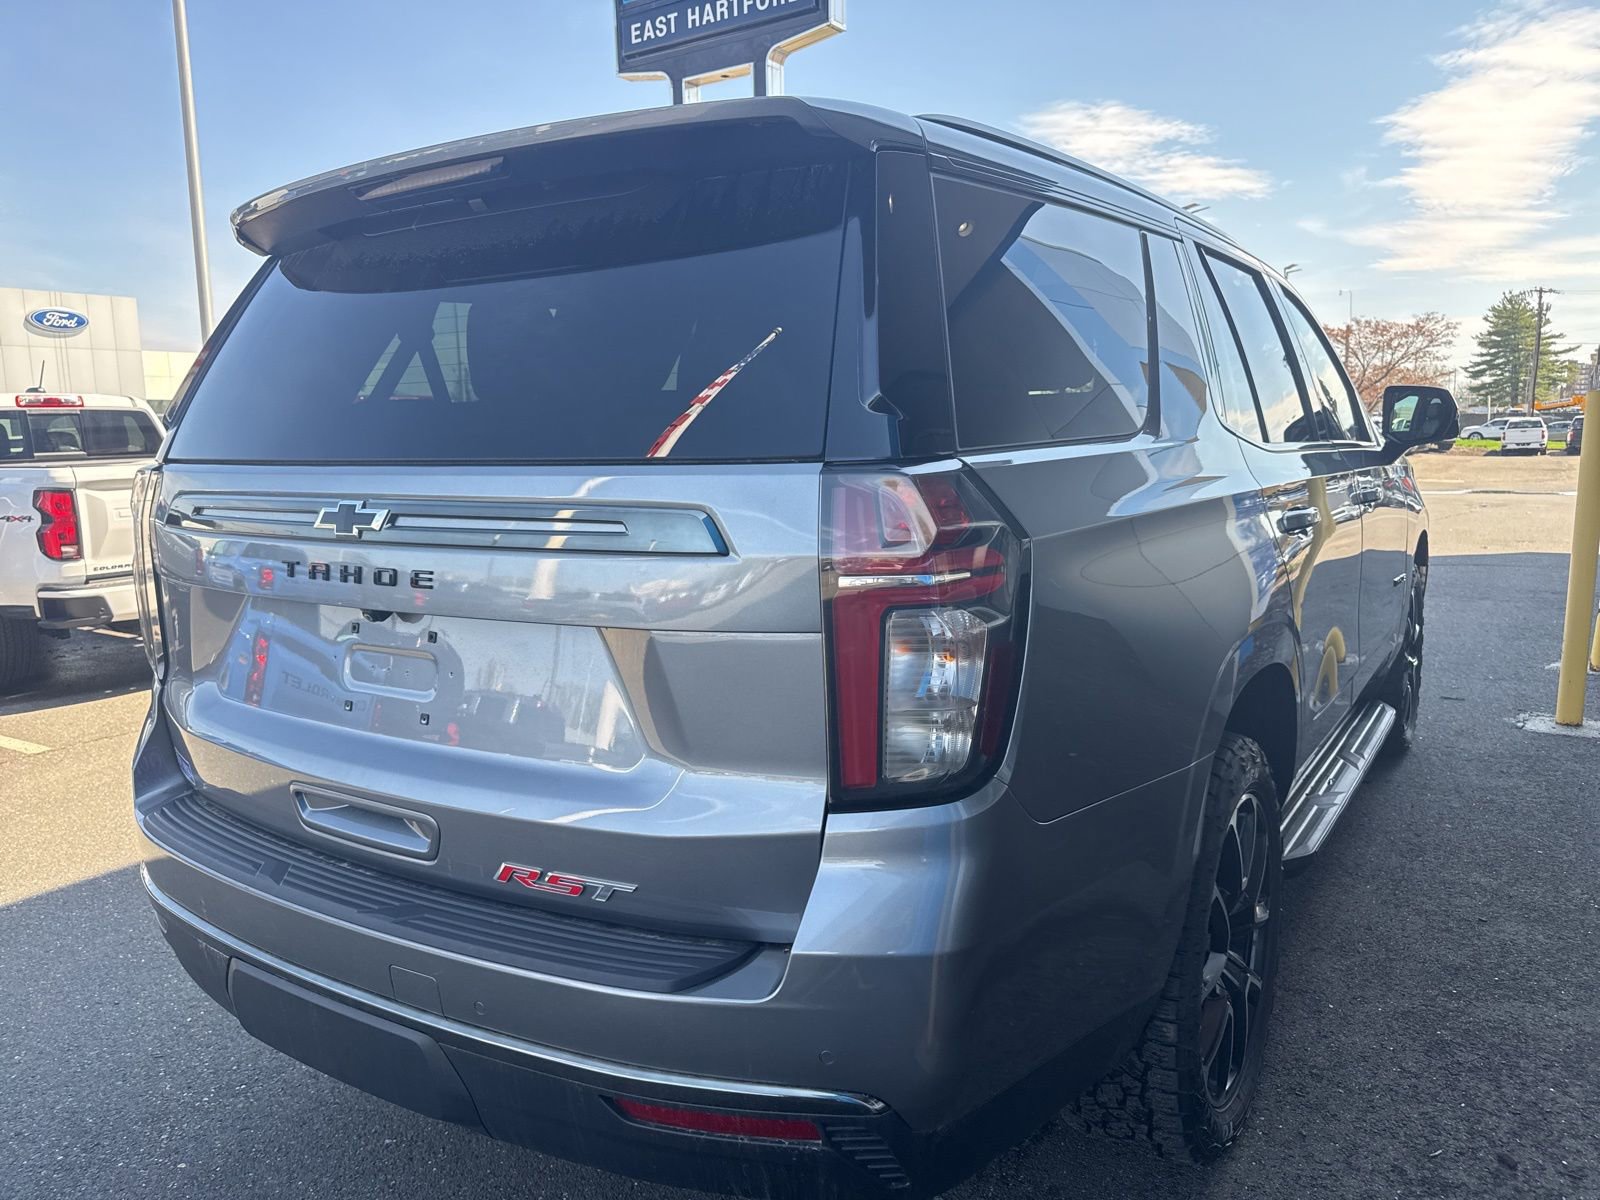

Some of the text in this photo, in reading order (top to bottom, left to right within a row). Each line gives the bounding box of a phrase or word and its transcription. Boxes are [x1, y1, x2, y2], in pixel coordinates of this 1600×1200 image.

[630, 0, 798, 45] EAST HARTFO
[42, 312, 78, 328] Ford
[93, 563, 132, 572] COLORA
[281, 560, 435, 590] TAHOE
[492, 861, 639, 903] RST
